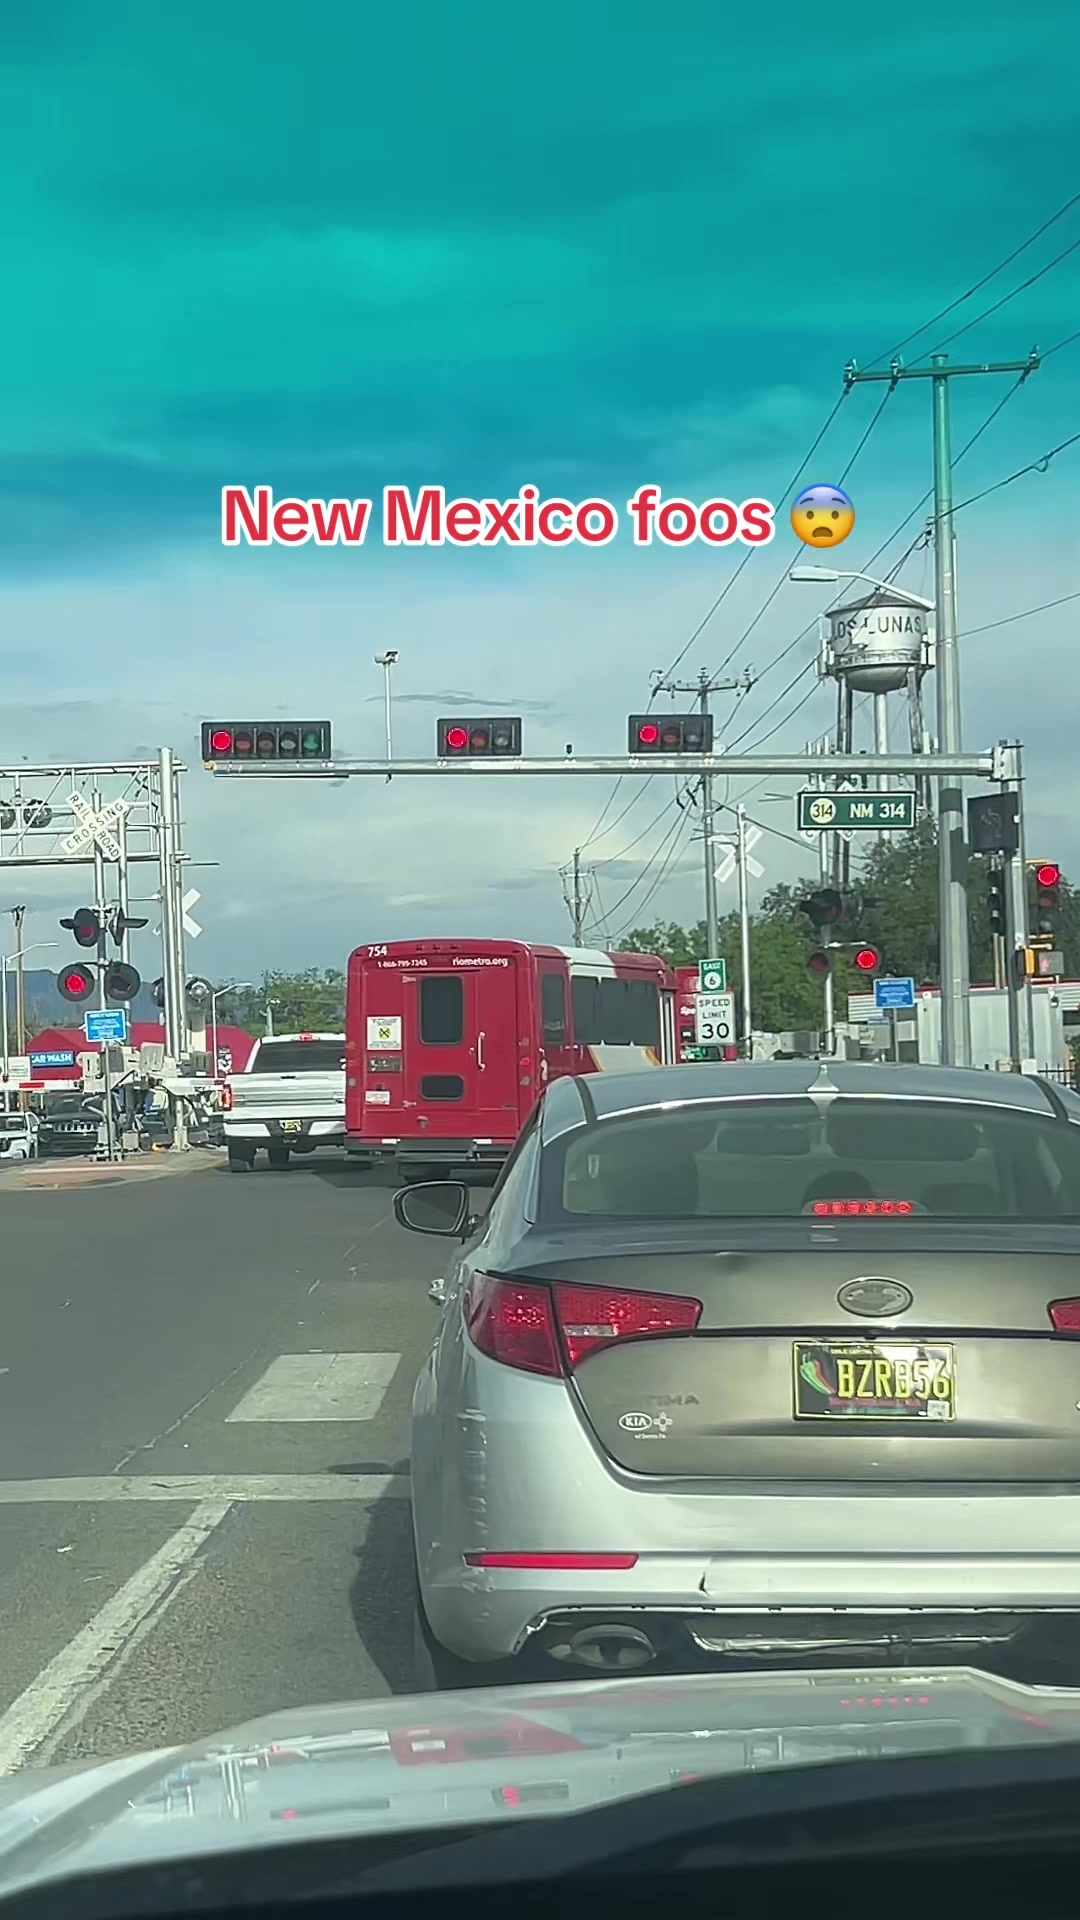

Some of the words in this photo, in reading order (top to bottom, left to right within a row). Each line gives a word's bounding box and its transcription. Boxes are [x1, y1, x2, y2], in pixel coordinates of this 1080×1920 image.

[811, 803, 833, 818] 314
[849, 802, 874, 819] NM
[879, 802, 906, 819] 314
[65, 802, 124, 850] CROSSING
[69, 793, 91, 821] RAIL
[97, 829, 120, 858] ROAD
[367, 945, 388, 957] 754
[452, 956, 508, 968] riometro.org
[709, 975, 716, 986] 6
[698, 998, 731, 1007] SPEED
[702, 1010, 727, 1019] LIMIT
[701, 1022, 730, 1040] 30
[46, 1053, 72, 1063] WASH
[836, 1358, 951, 1400] BZRB56
[625, 1415, 647, 1427] KIA
